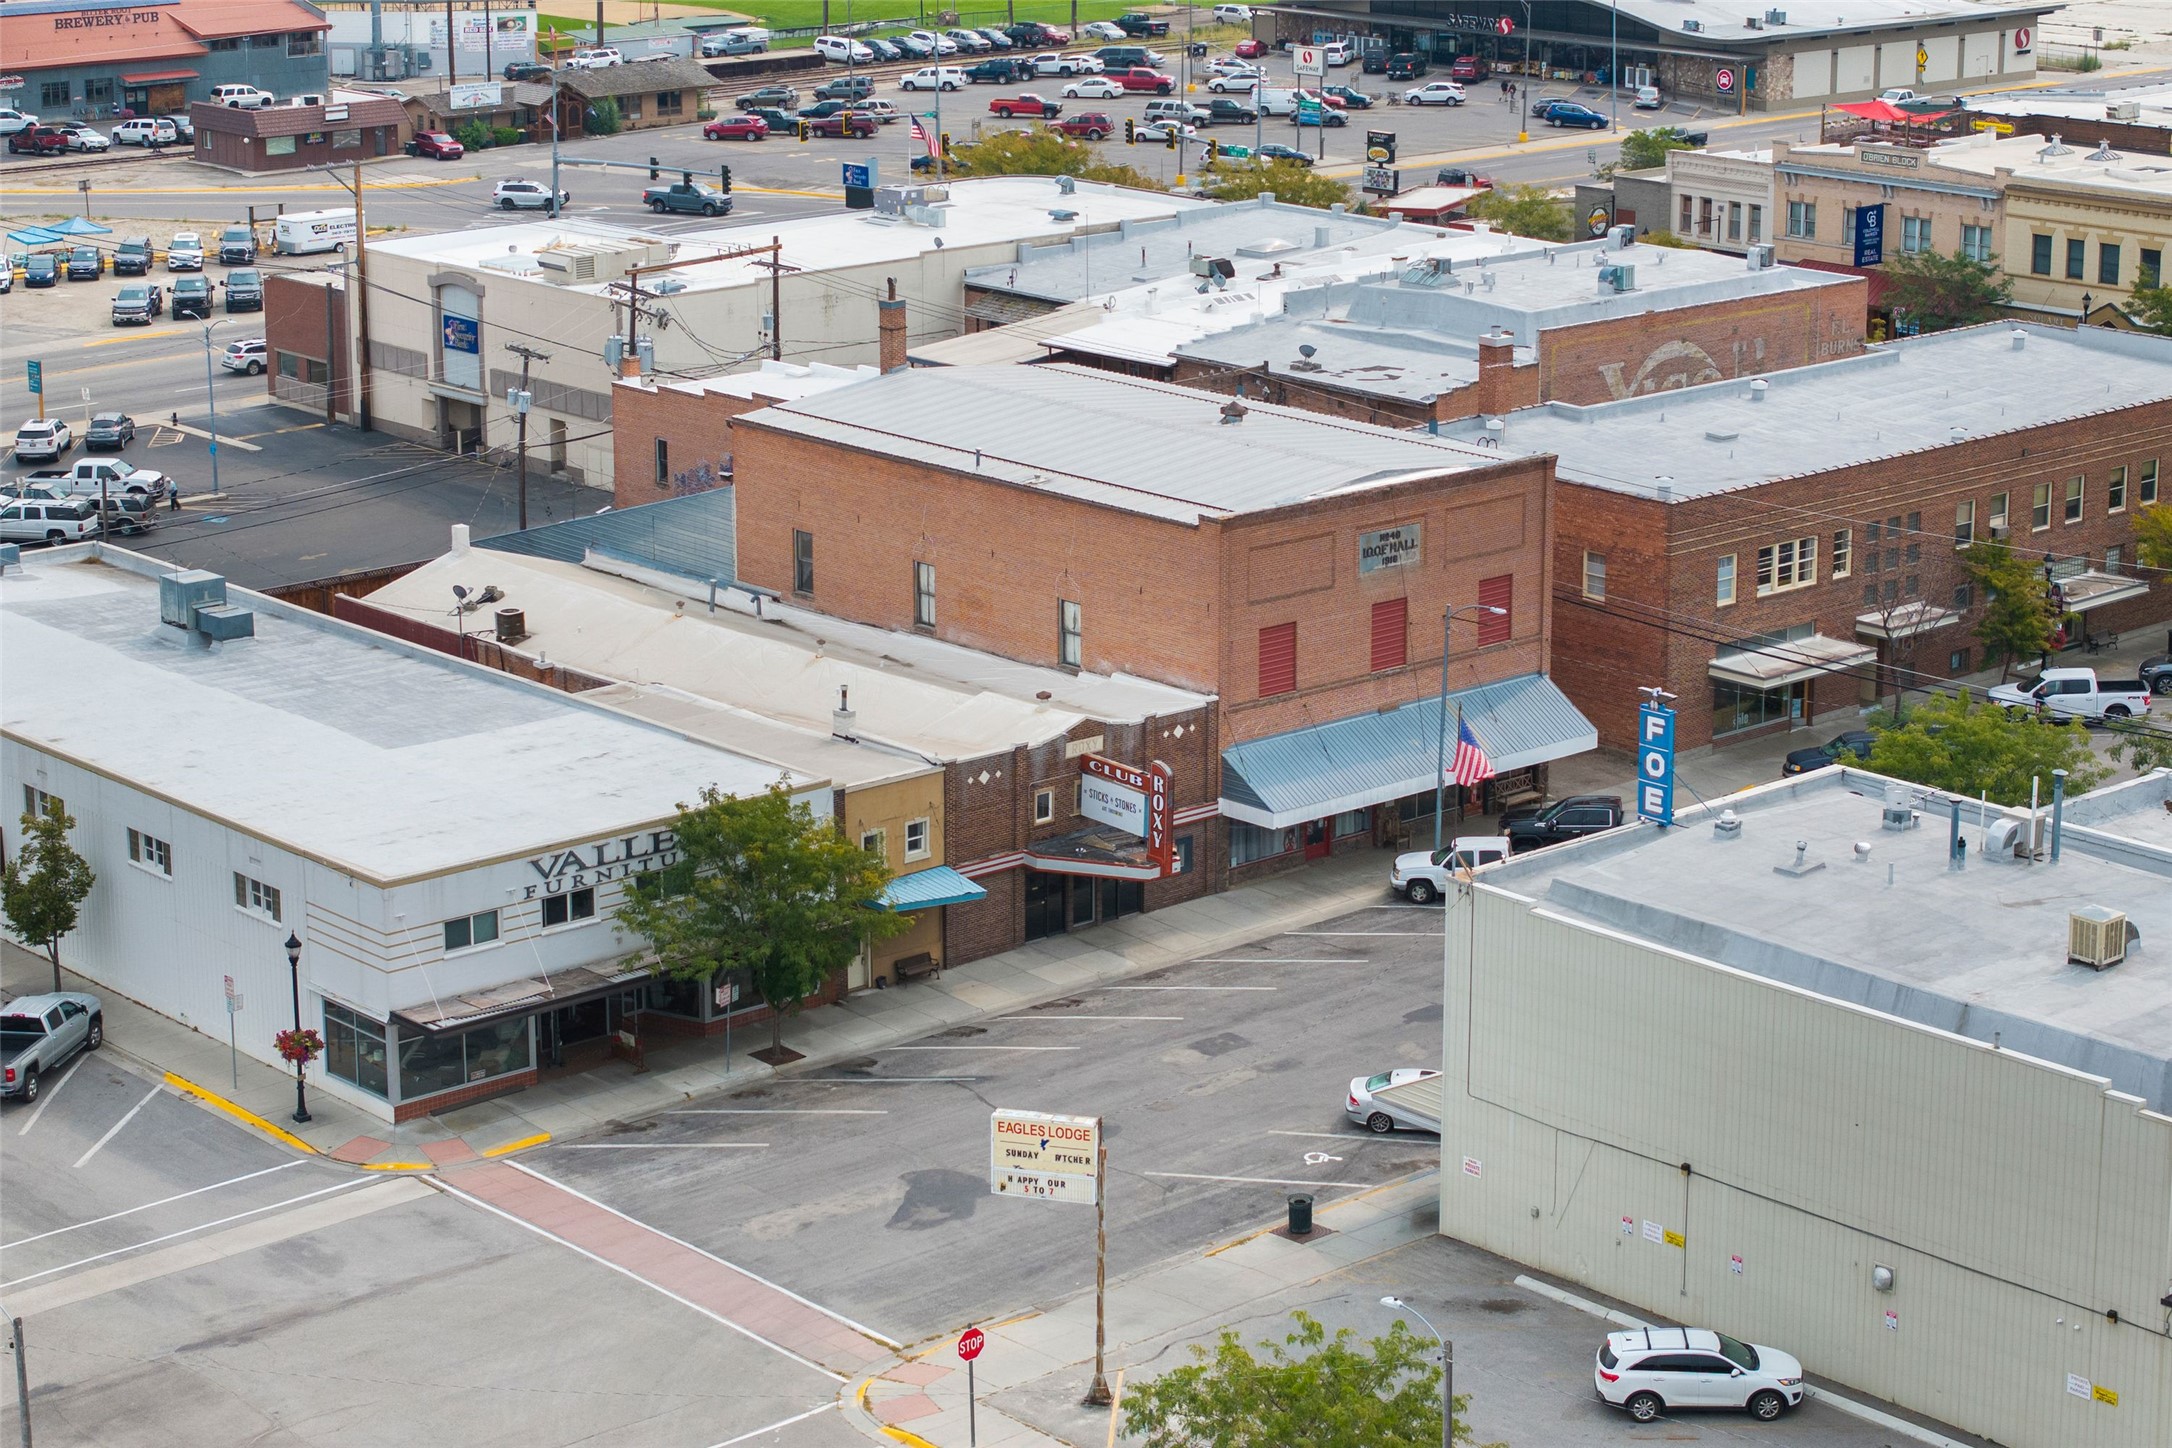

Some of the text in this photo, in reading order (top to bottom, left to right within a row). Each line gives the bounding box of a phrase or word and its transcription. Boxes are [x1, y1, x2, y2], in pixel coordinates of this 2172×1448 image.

[54, 14, 123, 29] BREWERY
[132, 11, 159, 23] PUB
[1447, 13, 1500, 32] SAFEWAY
[1296, 64, 1320, 73] SAFEWAY
[1863, 152, 1917, 167] O'BRIEN BLOCK
[1072, 740, 1099, 755] ROXY
[1088, 760, 1143, 787] CLUB
[1645, 715, 1667, 815] FOE
[1088, 788, 1109, 804] STICKS
[1114, 797, 1137, 814] STONES
[1152, 775, 1165, 849] ROXY
[528, 829, 676, 880] VALLE
[523, 852, 678, 900] FURNITU
[997, 1121, 1091, 1141] EAGLES LODGE
[1005, 1149, 1039, 1159] SUNDAY
[1034, 1186, 1045, 1194] TO
[1047, 1180, 1066, 1188] OUR
[959, 1335, 983, 1354] STOP
